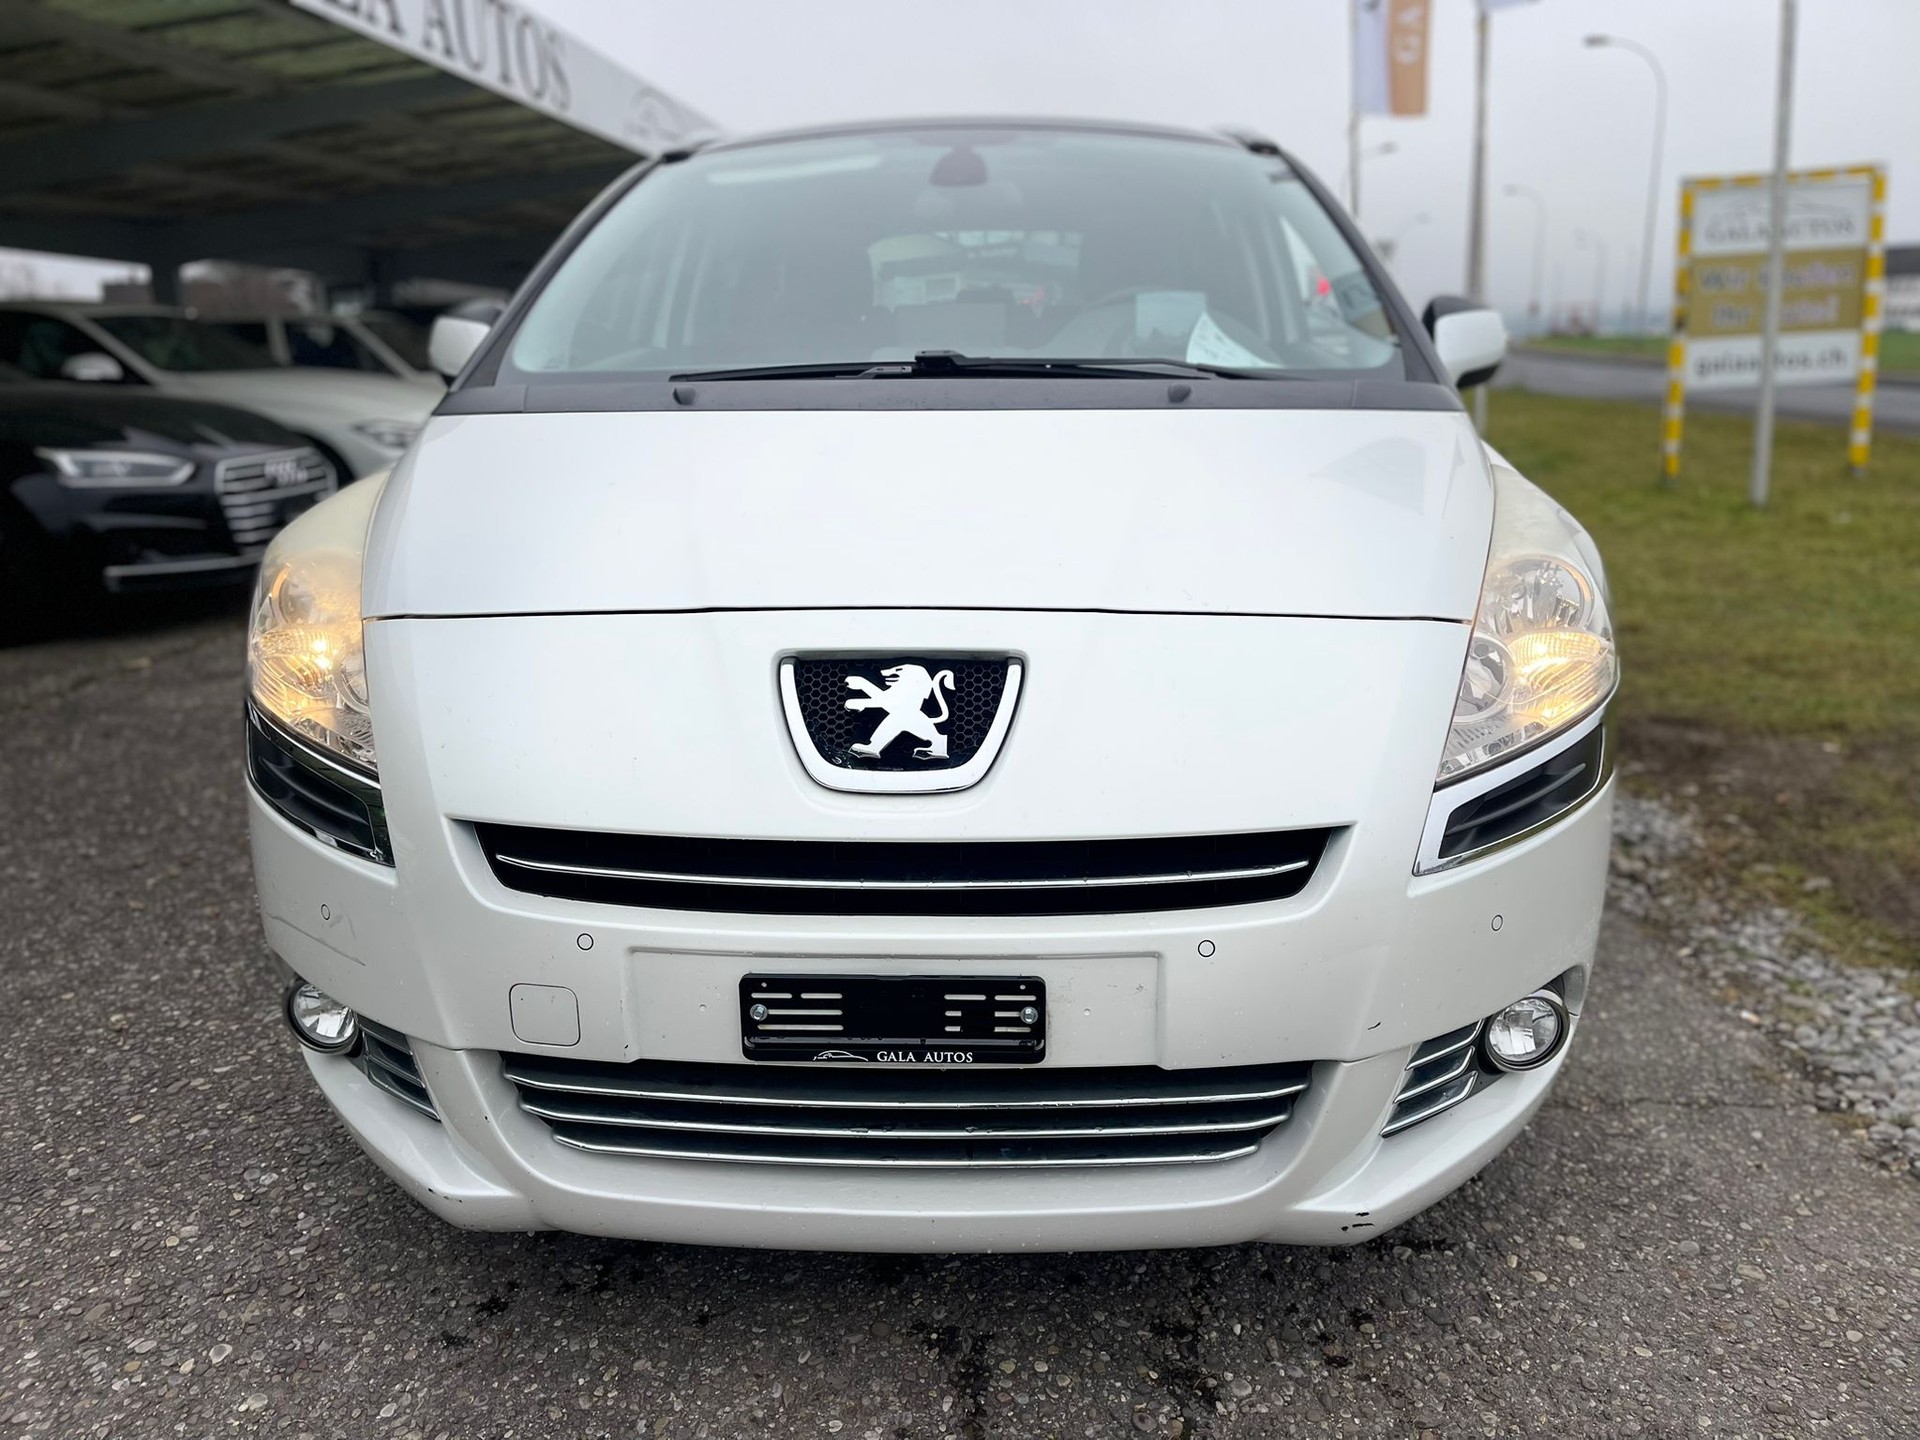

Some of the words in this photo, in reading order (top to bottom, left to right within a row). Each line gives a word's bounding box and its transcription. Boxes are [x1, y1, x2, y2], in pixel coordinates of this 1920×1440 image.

[422, 0, 571, 112] AUTOS
[876, 1050, 917, 1063] GALA
[923, 1051, 974, 1064] AUTOS
